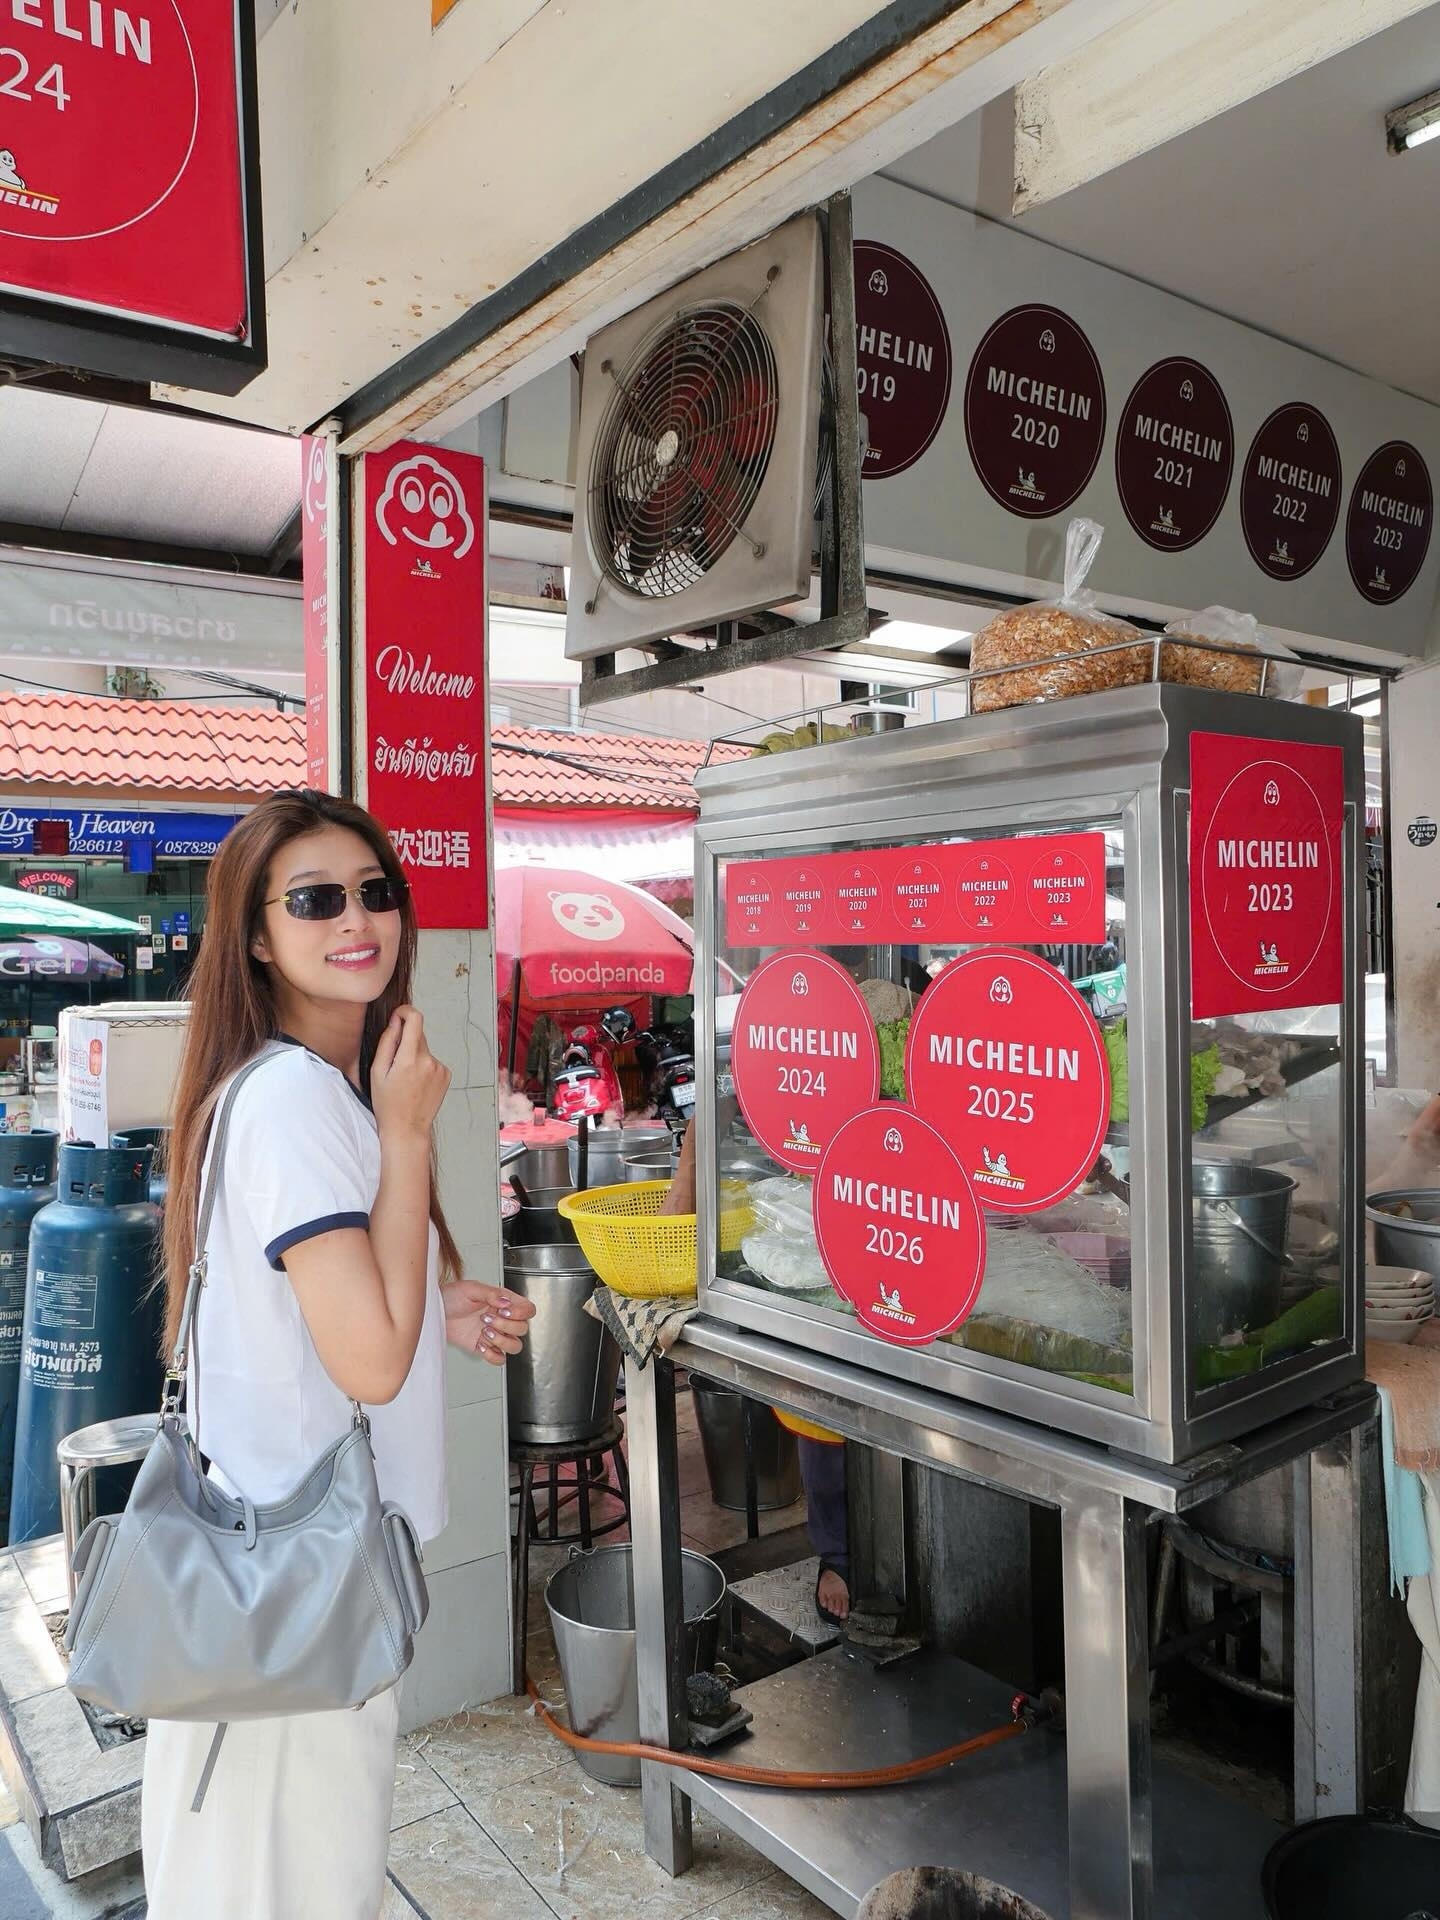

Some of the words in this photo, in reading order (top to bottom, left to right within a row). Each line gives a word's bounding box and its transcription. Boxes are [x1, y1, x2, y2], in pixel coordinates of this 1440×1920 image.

[0, 48, 71, 111] 24
[856, 324, 933, 372] HELIN
[987, 366, 1092, 421] MICHELIN
[1011, 413, 1060, 449] 2020
[1135, 414, 1222, 462] MICHELIN
[1154, 457, 1193, 488] 2021
[1257, 455, 1332, 498] MICHELIN
[1008, 487, 1045, 501] MICHELIN
[1272, 493, 1307, 523] 2022
[1361, 490, 1425, 527] MICHELIN
[1150, 523, 1181, 536] MICHELIN
[1373, 525, 1403, 551] 2023
[410, 570, 441, 579] MICHELIN
[375, 645, 476, 699] Welcome
[374, 735, 478, 782] ยินดีต้อนรับ
[71, 813, 155, 840] Heaven
[388, 828, 470, 868] 欢迎语
[1217, 839, 1319, 868] MICHELIN
[19, 872, 75, 889] WELCOME
[28, 884, 67, 898] OPEN
[839, 887, 877, 898] MICHELIN
[897, 883, 940, 896] MICHELIN
[961, 880, 1009, 892] MICHELIN
[1033, 876, 1085, 889] MICHELIN
[737, 893, 770, 904] MICHELIN
[786, 890, 821, 901] MICHELIN
[795, 903, 812, 913] 2019
[849, 900, 868, 911] 2020
[908, 898, 928, 908] 2021
[974, 895, 996, 906] 2022
[1047, 892, 1071, 904] 2023
[1248, 883, 1293, 912] 2023
[745, 906, 762, 916] 2018
[550, 961, 665, 987] foodpanda
[1253, 965, 1289, 976] MICHELIN
[749, 1024, 857, 1059] MICHELIN
[930, 1034, 1079, 1081] MICHELIN
[777, 1066, 827, 1097] 2024
[967, 1085, 1034, 1124] 2025
[783, 1142, 821, 1155] MICHELIN
[973, 1173, 1025, 1190] MICHELIN
[833, 1174, 960, 1230] MICHELIN
[865, 1224, 924, 1265] 2026
[871, 1305, 916, 1325] MICHELIN
[79, 1342, 100, 1352] 2573
